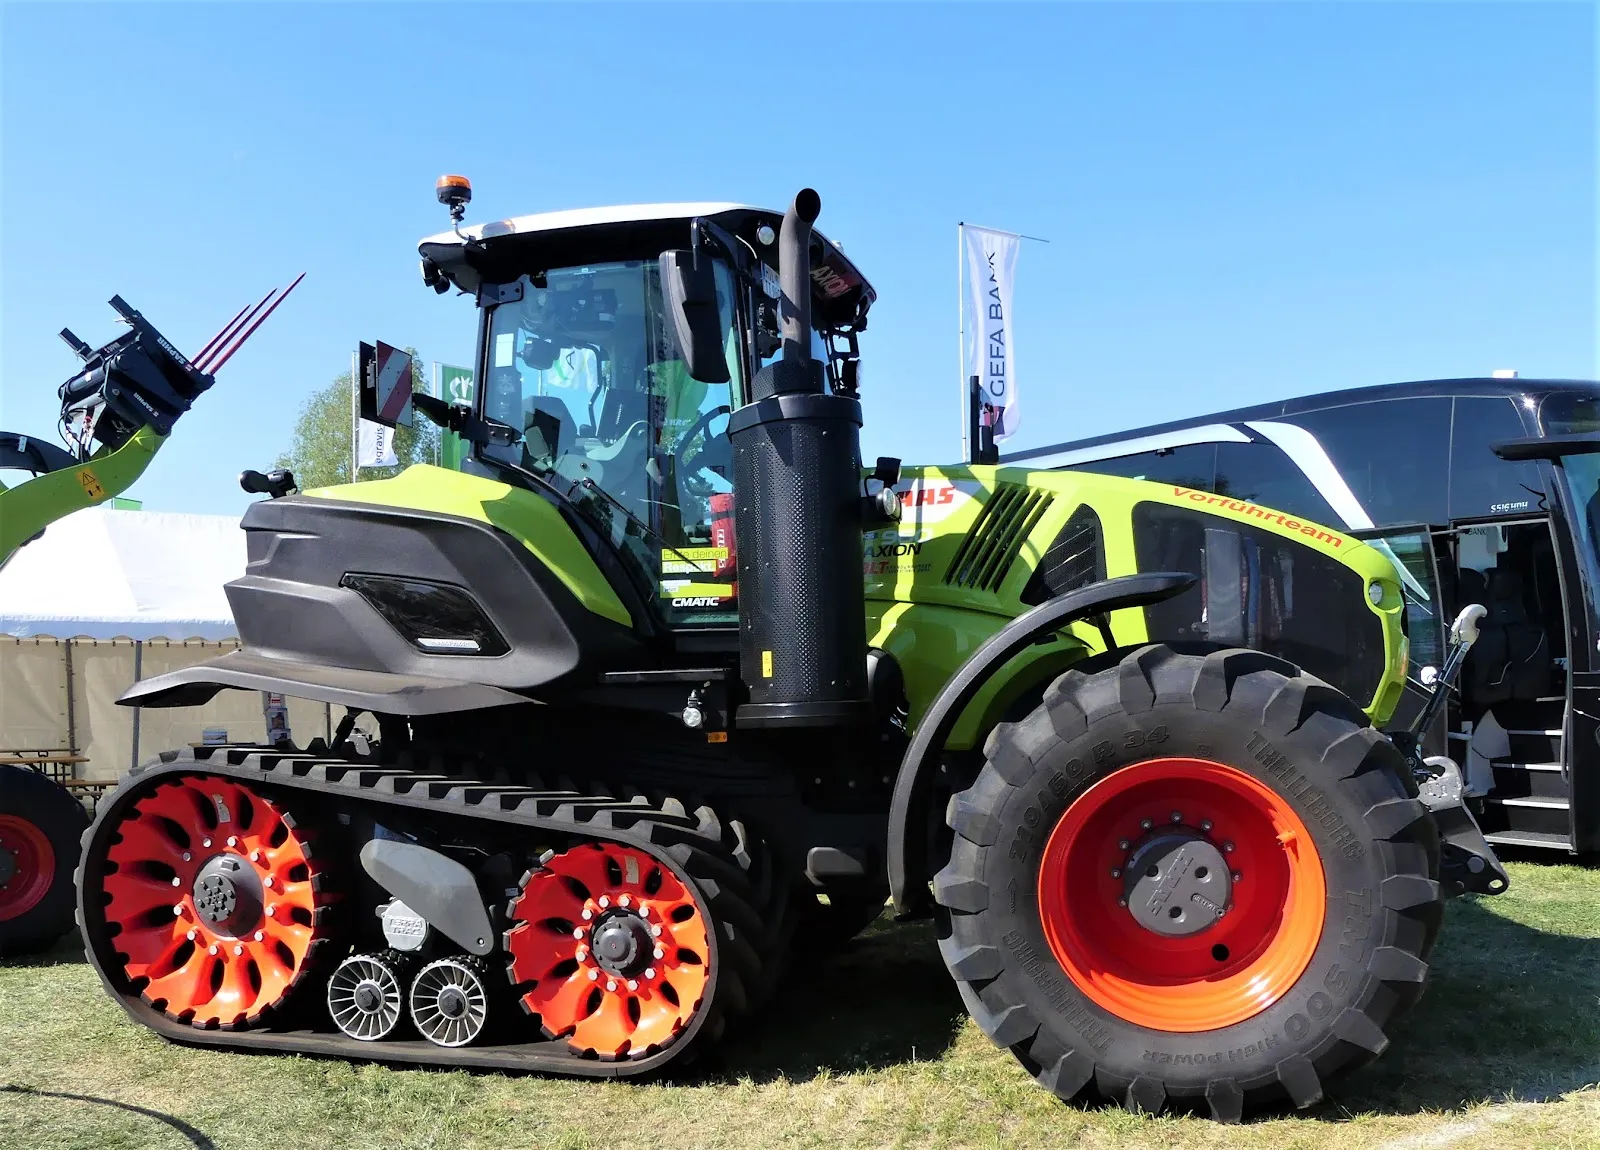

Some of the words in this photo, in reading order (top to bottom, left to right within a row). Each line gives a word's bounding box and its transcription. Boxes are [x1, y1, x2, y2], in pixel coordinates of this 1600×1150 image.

[156, 336, 187, 366] SAPHIR
[990, 328, 1005, 397] GEFA
[896, 487, 956, 507] AAS
[1174, 487, 1343, 548] Vorführteam
[692, 548, 727, 559] deinen
[863, 542, 923, 558] AXION
[672, 597, 720, 607] CMATIC
[1123, 724, 1170, 749] 34
[1244, 729, 1367, 861] TRELLEBORG
[1002, 929, 1116, 1056] TRELLEBORG
[1142, 1049, 1223, 1066] POWER
